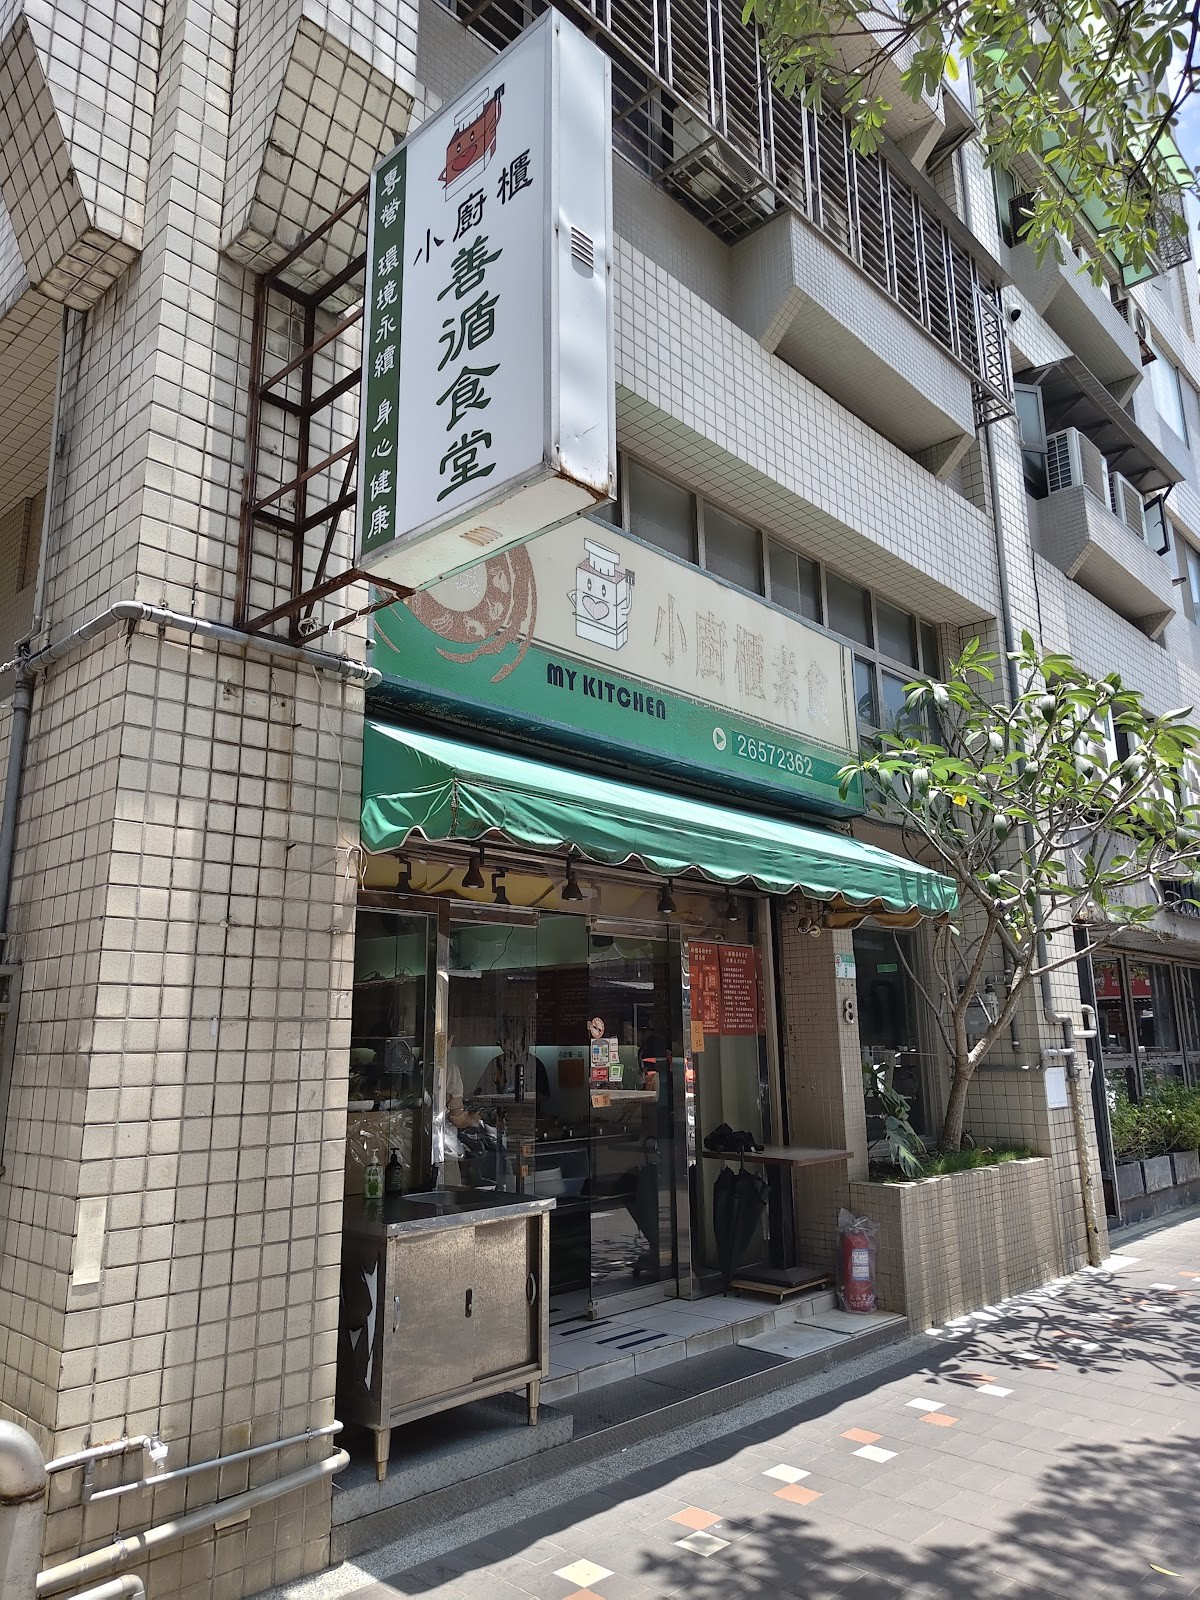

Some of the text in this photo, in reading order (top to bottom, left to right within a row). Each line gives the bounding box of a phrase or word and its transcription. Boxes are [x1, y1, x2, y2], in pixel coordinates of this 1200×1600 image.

[413, 148, 534, 267] 小廚櫃
[373, 244, 399, 378] 環境永續
[436, 235, 503, 502] 善循食堂
[367, 398, 393, 540] 身心健康
[547, 663, 666, 720] MY KITCHEN
[737, 735, 813, 778] 26572362
